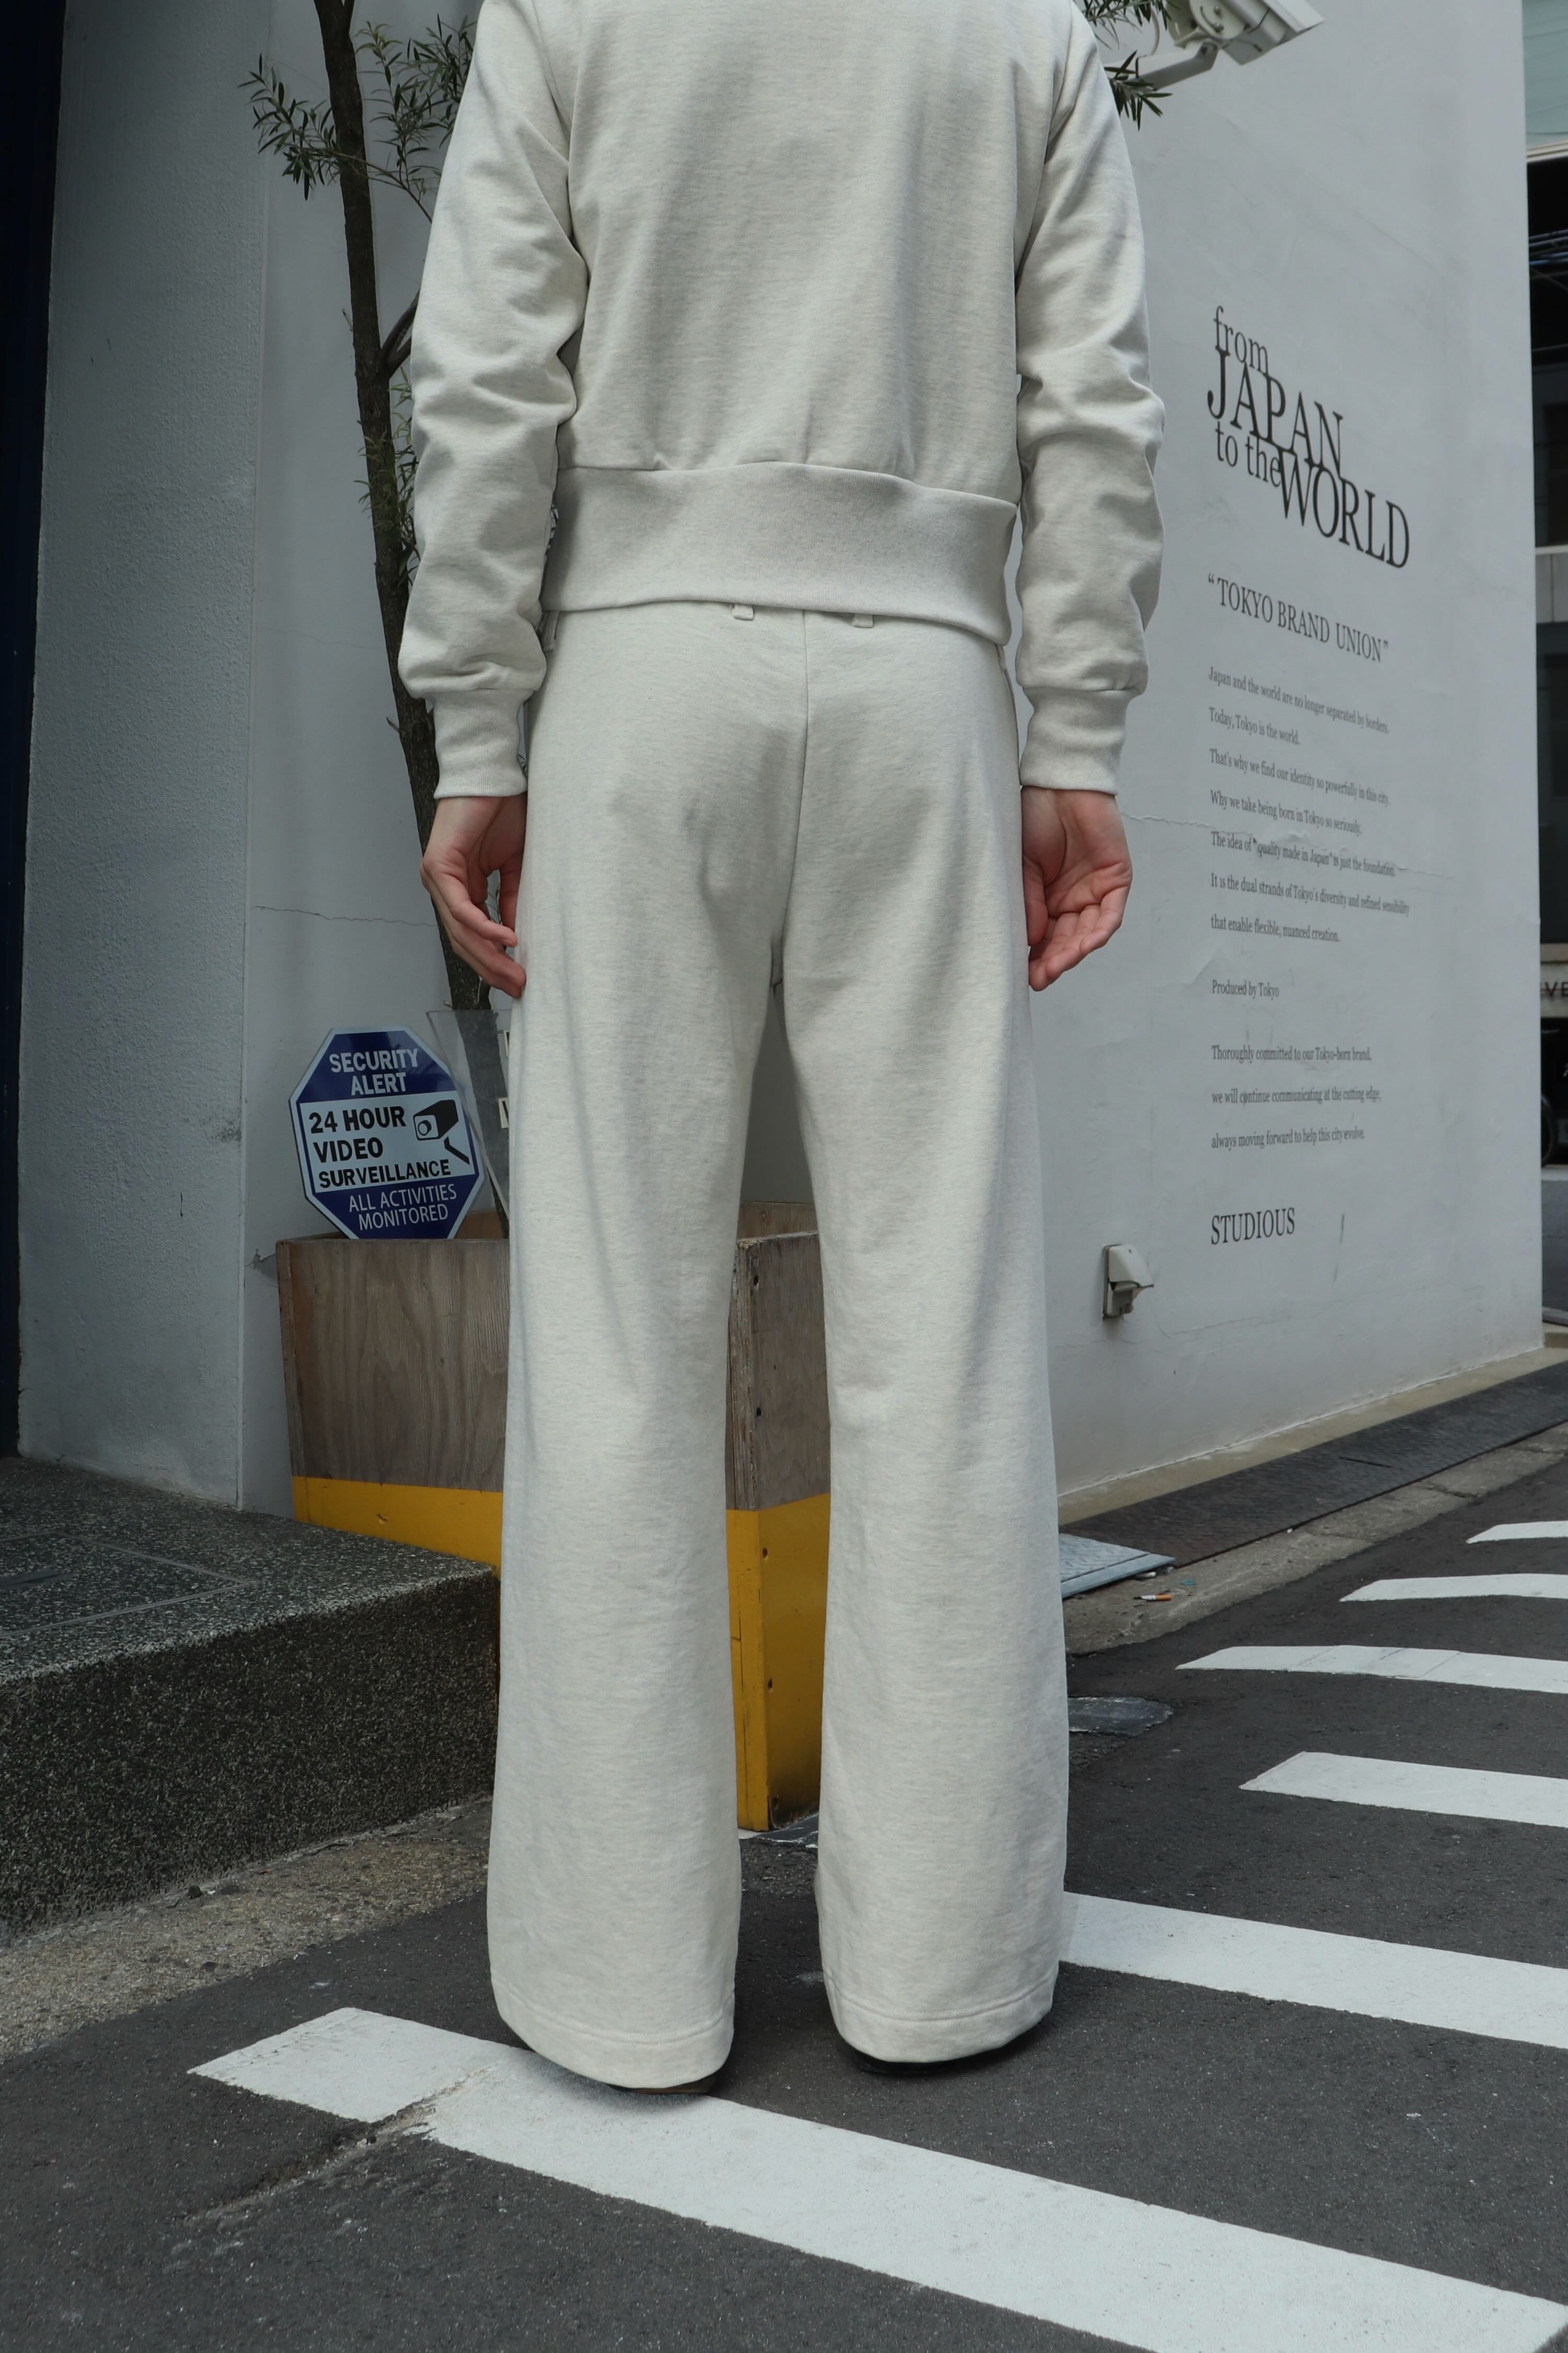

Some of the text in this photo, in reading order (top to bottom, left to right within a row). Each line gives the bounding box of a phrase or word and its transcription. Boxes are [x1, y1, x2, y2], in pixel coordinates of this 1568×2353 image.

[1214, 305, 1269, 373] from
[1207, 350, 1343, 476] JAPAN
[1215, 421, 1410, 568] to the WORLD
[1278, 600, 1330, 644] BRAND
[1208, 665, 1389, 733] Japan and the world are no longer separated by borders.
[1209, 707, 1300, 745] Today, Tokyo is the world.
[1233, 754, 1249, 774] why
[1250, 762, 1260, 774] we
[1261, 761, 1275, 777] find
[1276, 769, 1288, 781] our
[1290, 767, 1315, 790] identity
[1317, 778, 1324, 789] so
[1325, 780, 1358, 800] powerfully
[1359, 785, 1365, 799] in
[1366, 787, 1378, 802] this
[1210, 789, 1228, 810] Why
[1230, 797, 1240, 809] we
[1242, 796, 1256, 812] take
[1258, 799, 1278, 820] being
[1278, 803, 1295, 820] born
[1296, 808, 1303, 822] in
[1304, 810, 1324, 829] Tokyo
[1325, 818, 1333, 828] so
[1211, 831, 1226, 847] The
[1228, 832, 1242, 850] idea
[1244, 836, 1252, 852] of
[1283, 845, 1300, 860] made
[1301, 846, 1308, 862] in
[1333, 853, 1339, 867] is
[1339, 854, 1352, 871] just
[1353, 856, 1362, 870] the
[1211, 873, 1217, 887] It
[1219, 877, 1226, 888] is
[1228, 874, 1239, 891] the
[1241, 876, 1257, 892] dual
[1259, 881, 1284, 897] strands
[1286, 883, 1293, 898] of
[1320, 888, 1347, 909] diversity
[1348, 893, 1359, 908] and
[1361, 896, 1381, 910] refined
[1212, 913, 1226, 929] that
[1229, 916, 1253, 933] enable
[1283, 925, 1310, 939] nuanced
[1312, 927, 1340, 942] creation.
[1212, 979, 1279, 1000] Produced by Tokyo
[329, 1048, 419, 1073] SECURITY
[1212, 1044, 1254, 1064] Thoroughly
[1256, 1046, 1293, 1060] committed
[1294, 1047, 1301, 1060] to
[1302, 1050, 1314, 1060] our
[1315, 1046, 1351, 1064] Tokyo-born
[351, 1073, 407, 1096] ALERT
[1212, 1093, 1223, 1103] we
[1225, 1088, 1238, 1103] will
[1240, 1087, 1270, 1104] continue
[1272, 1087, 1322, 1104] communicating
[1324, 1089, 1330, 1101] at
[1332, 1086, 1342, 1100] the
[1343, 1086, 1364, 1104] cutting
[308, 1106, 407, 1134] 24 HOUR
[313, 1137, 384, 1163] VIDEO
[1212, 1125, 1365, 1151] always moving forward to help this city evolve.
[318, 1159, 452, 1189] SURVEILLANCE
[349, 1184, 457, 1213] ALL ACTIVITIES
[359, 1204, 448, 1231] MONITORED
[1211, 1207, 1295, 1245] STUDIOUS
